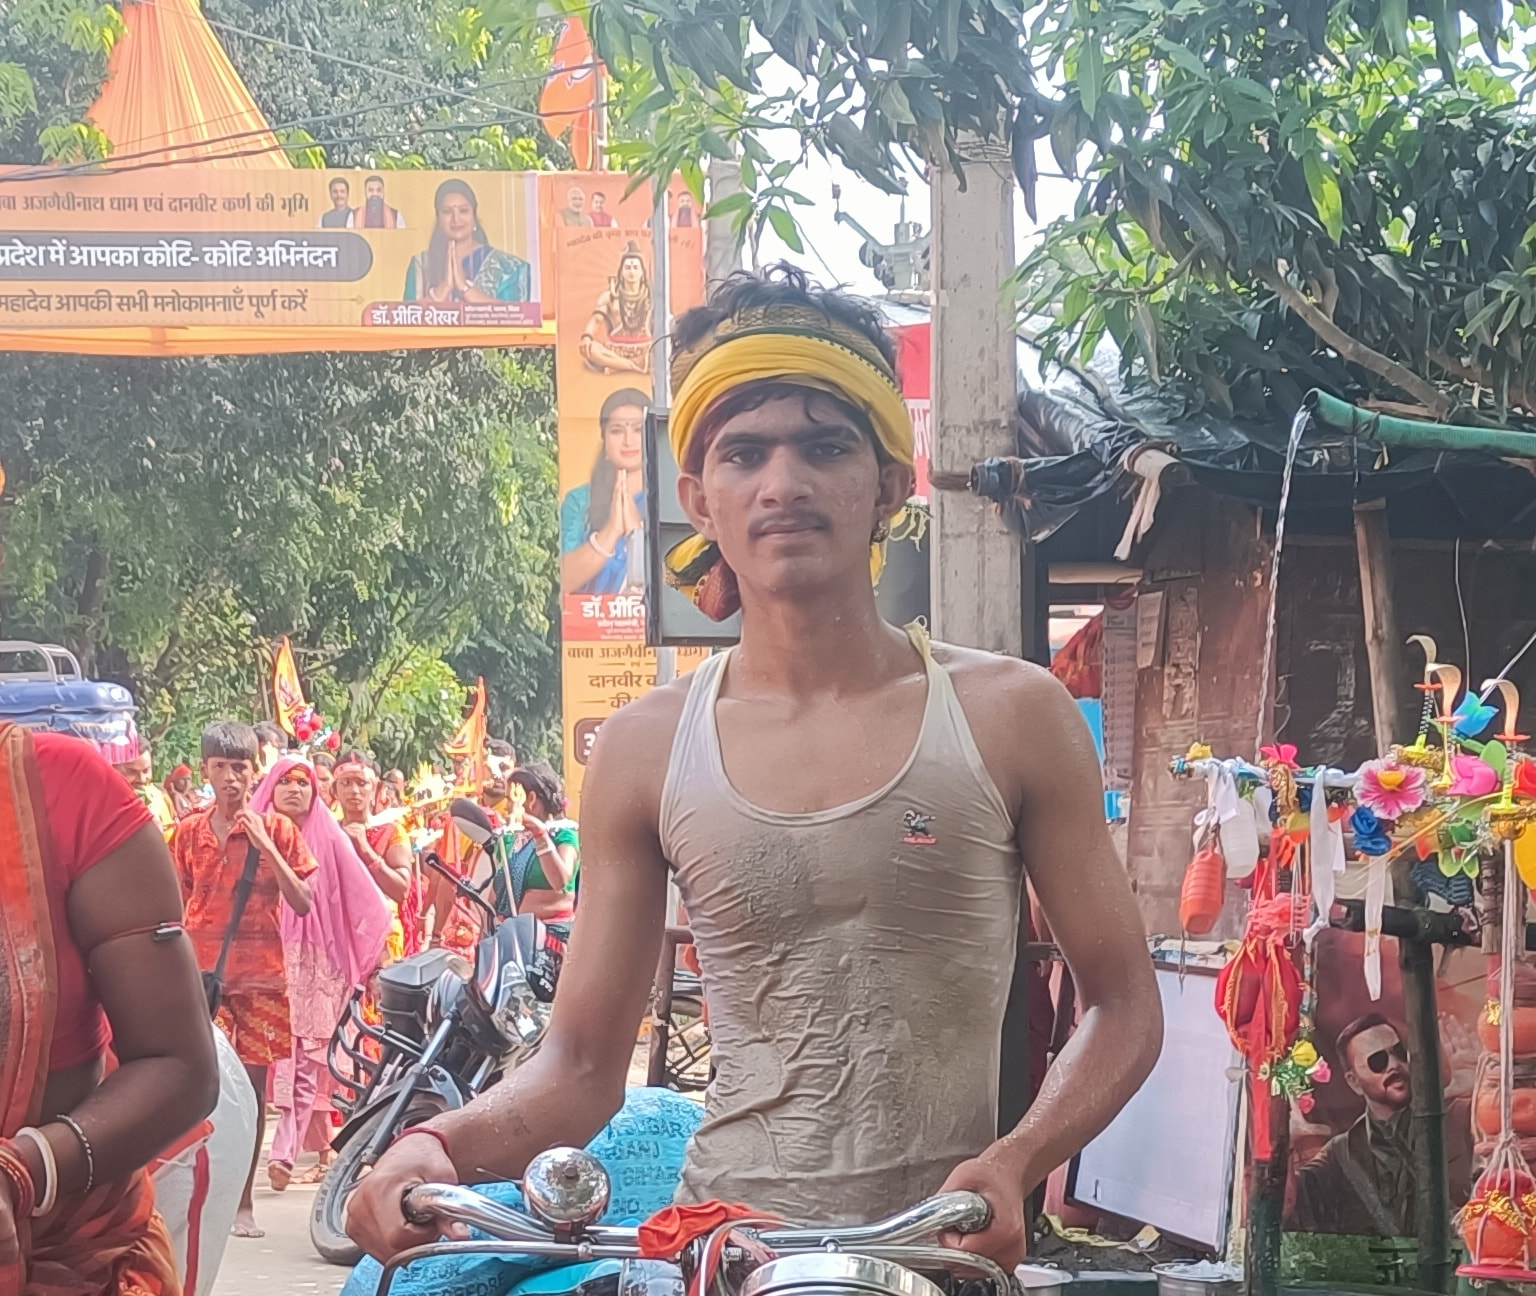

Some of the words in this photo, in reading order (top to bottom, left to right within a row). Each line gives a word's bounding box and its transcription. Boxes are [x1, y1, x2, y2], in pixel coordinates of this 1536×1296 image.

[168, 193, 217, 212] दानवीर
[222, 192, 251, 212] कर्ण
[256, 193, 275, 212] की
[47, 238, 67, 266] में
[69, 245, 140, 267] आपका
[142, 240, 199, 267] कोटि-
[202, 240, 252, 267] कोटि
[256, 241, 338, 267] अभिनंदन
[55, 289, 114, 312] आपकी
[116, 289, 149, 312] सभी
[152, 286, 245, 312] मनोकामनाएँ
[247, 289, 278, 318] पूर्ण
[280, 289, 309, 312] करें
[371, 305, 390, 325] डॉ.
[392, 305, 423, 325] प्रीति
[424, 305, 459, 325] शेखर
[581, 595, 606, 618] डॉ.
[588, 670, 643, 688] दानवीर
